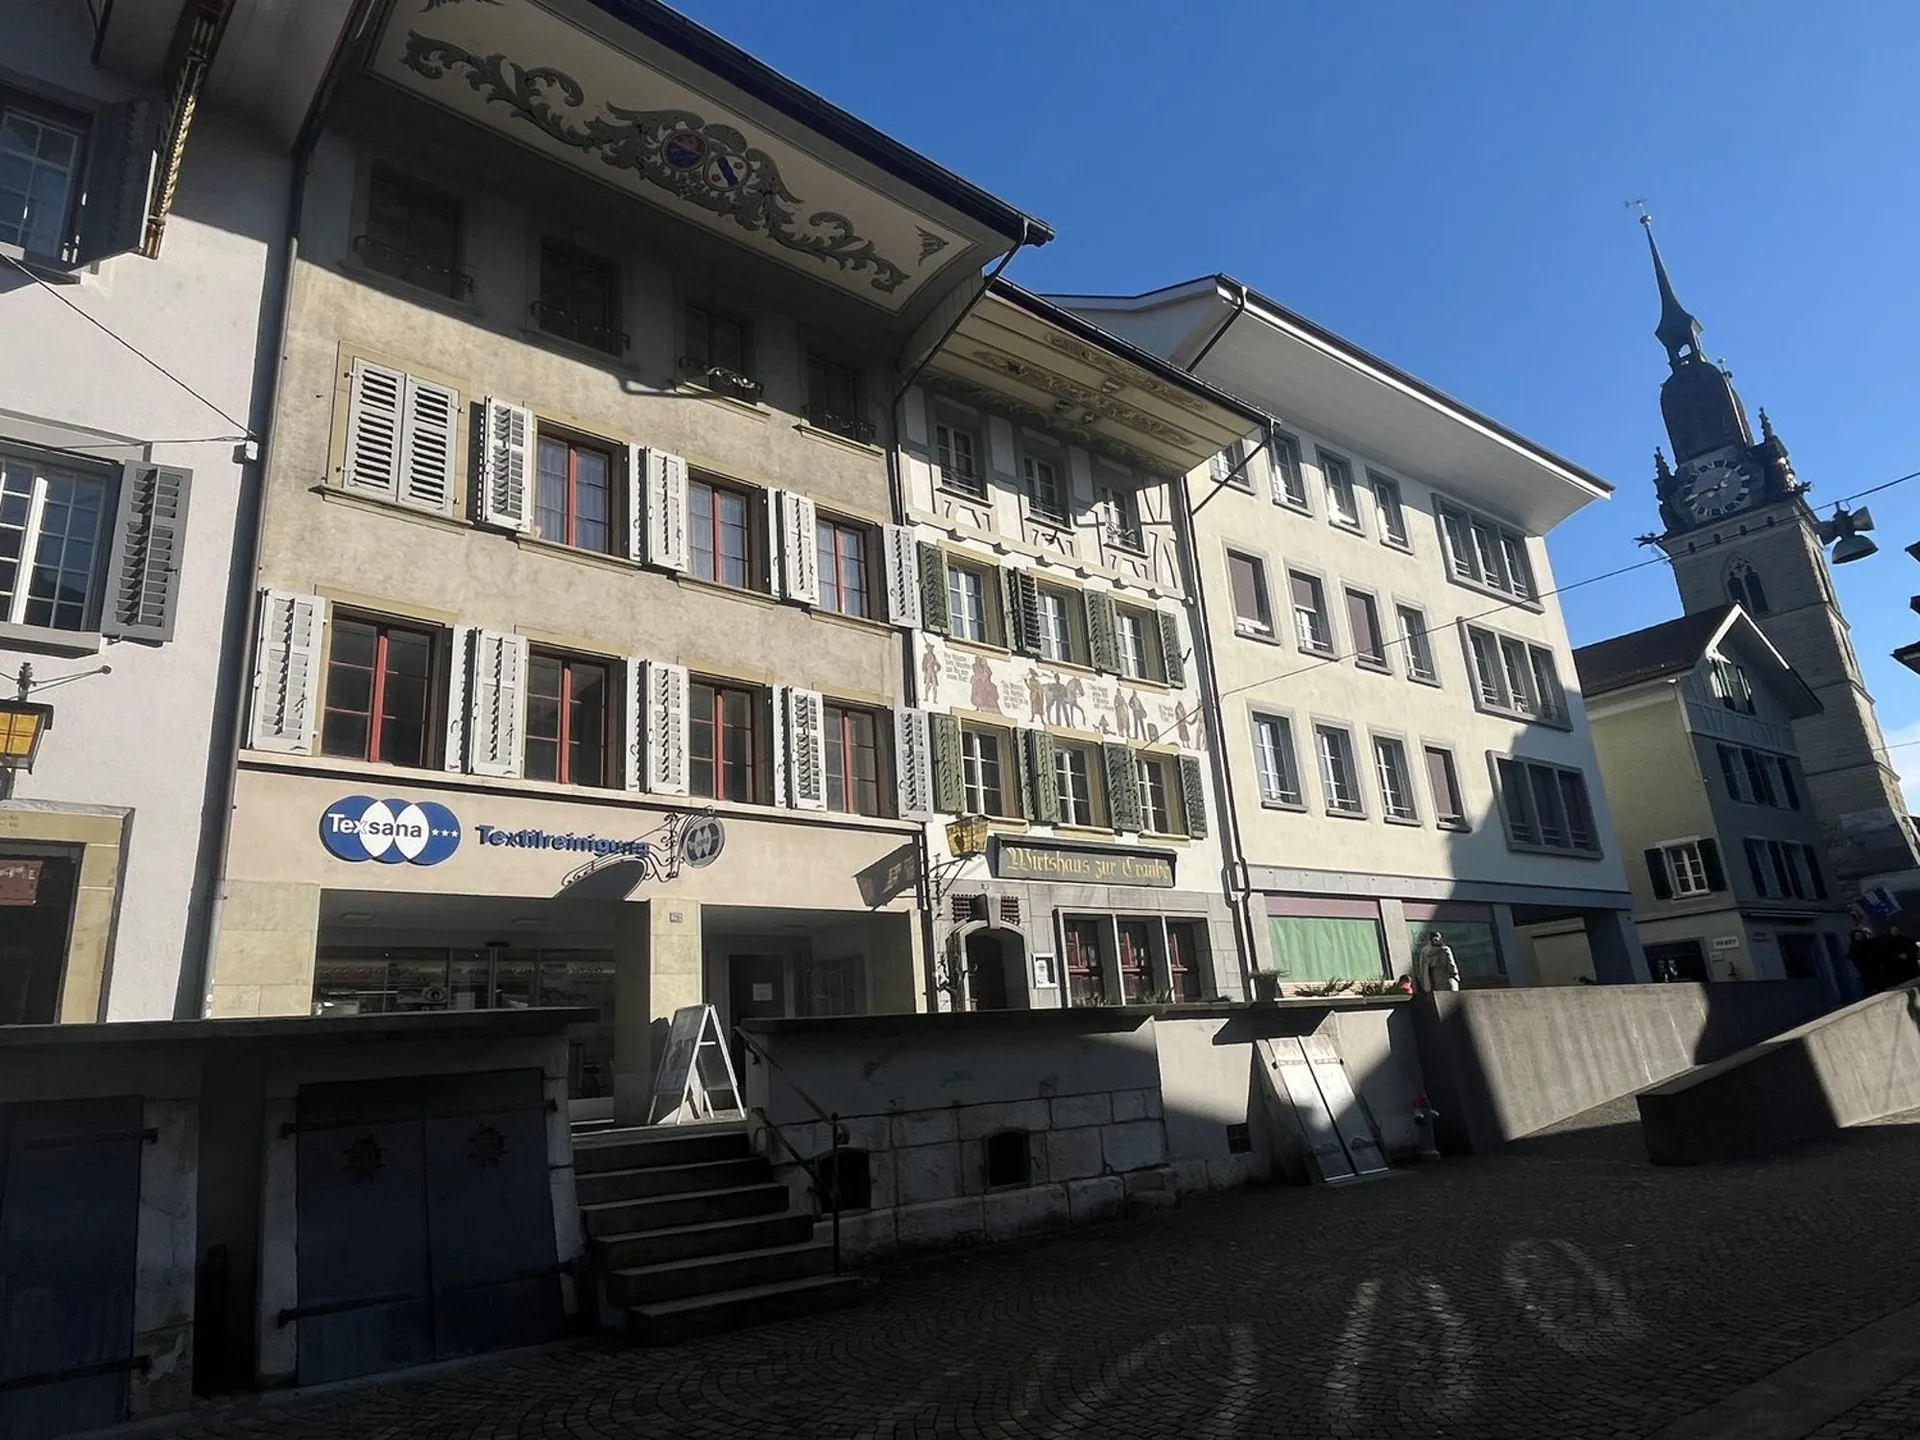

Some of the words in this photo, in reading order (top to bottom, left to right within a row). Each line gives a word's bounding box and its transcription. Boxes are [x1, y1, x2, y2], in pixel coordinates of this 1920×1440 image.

[327, 813, 422, 838] Texsana
[475, 824, 650, 858] Textilreinigung
[1005, 847, 1091, 875] Wirtshaus
[1095, 859, 1117, 879] zur
